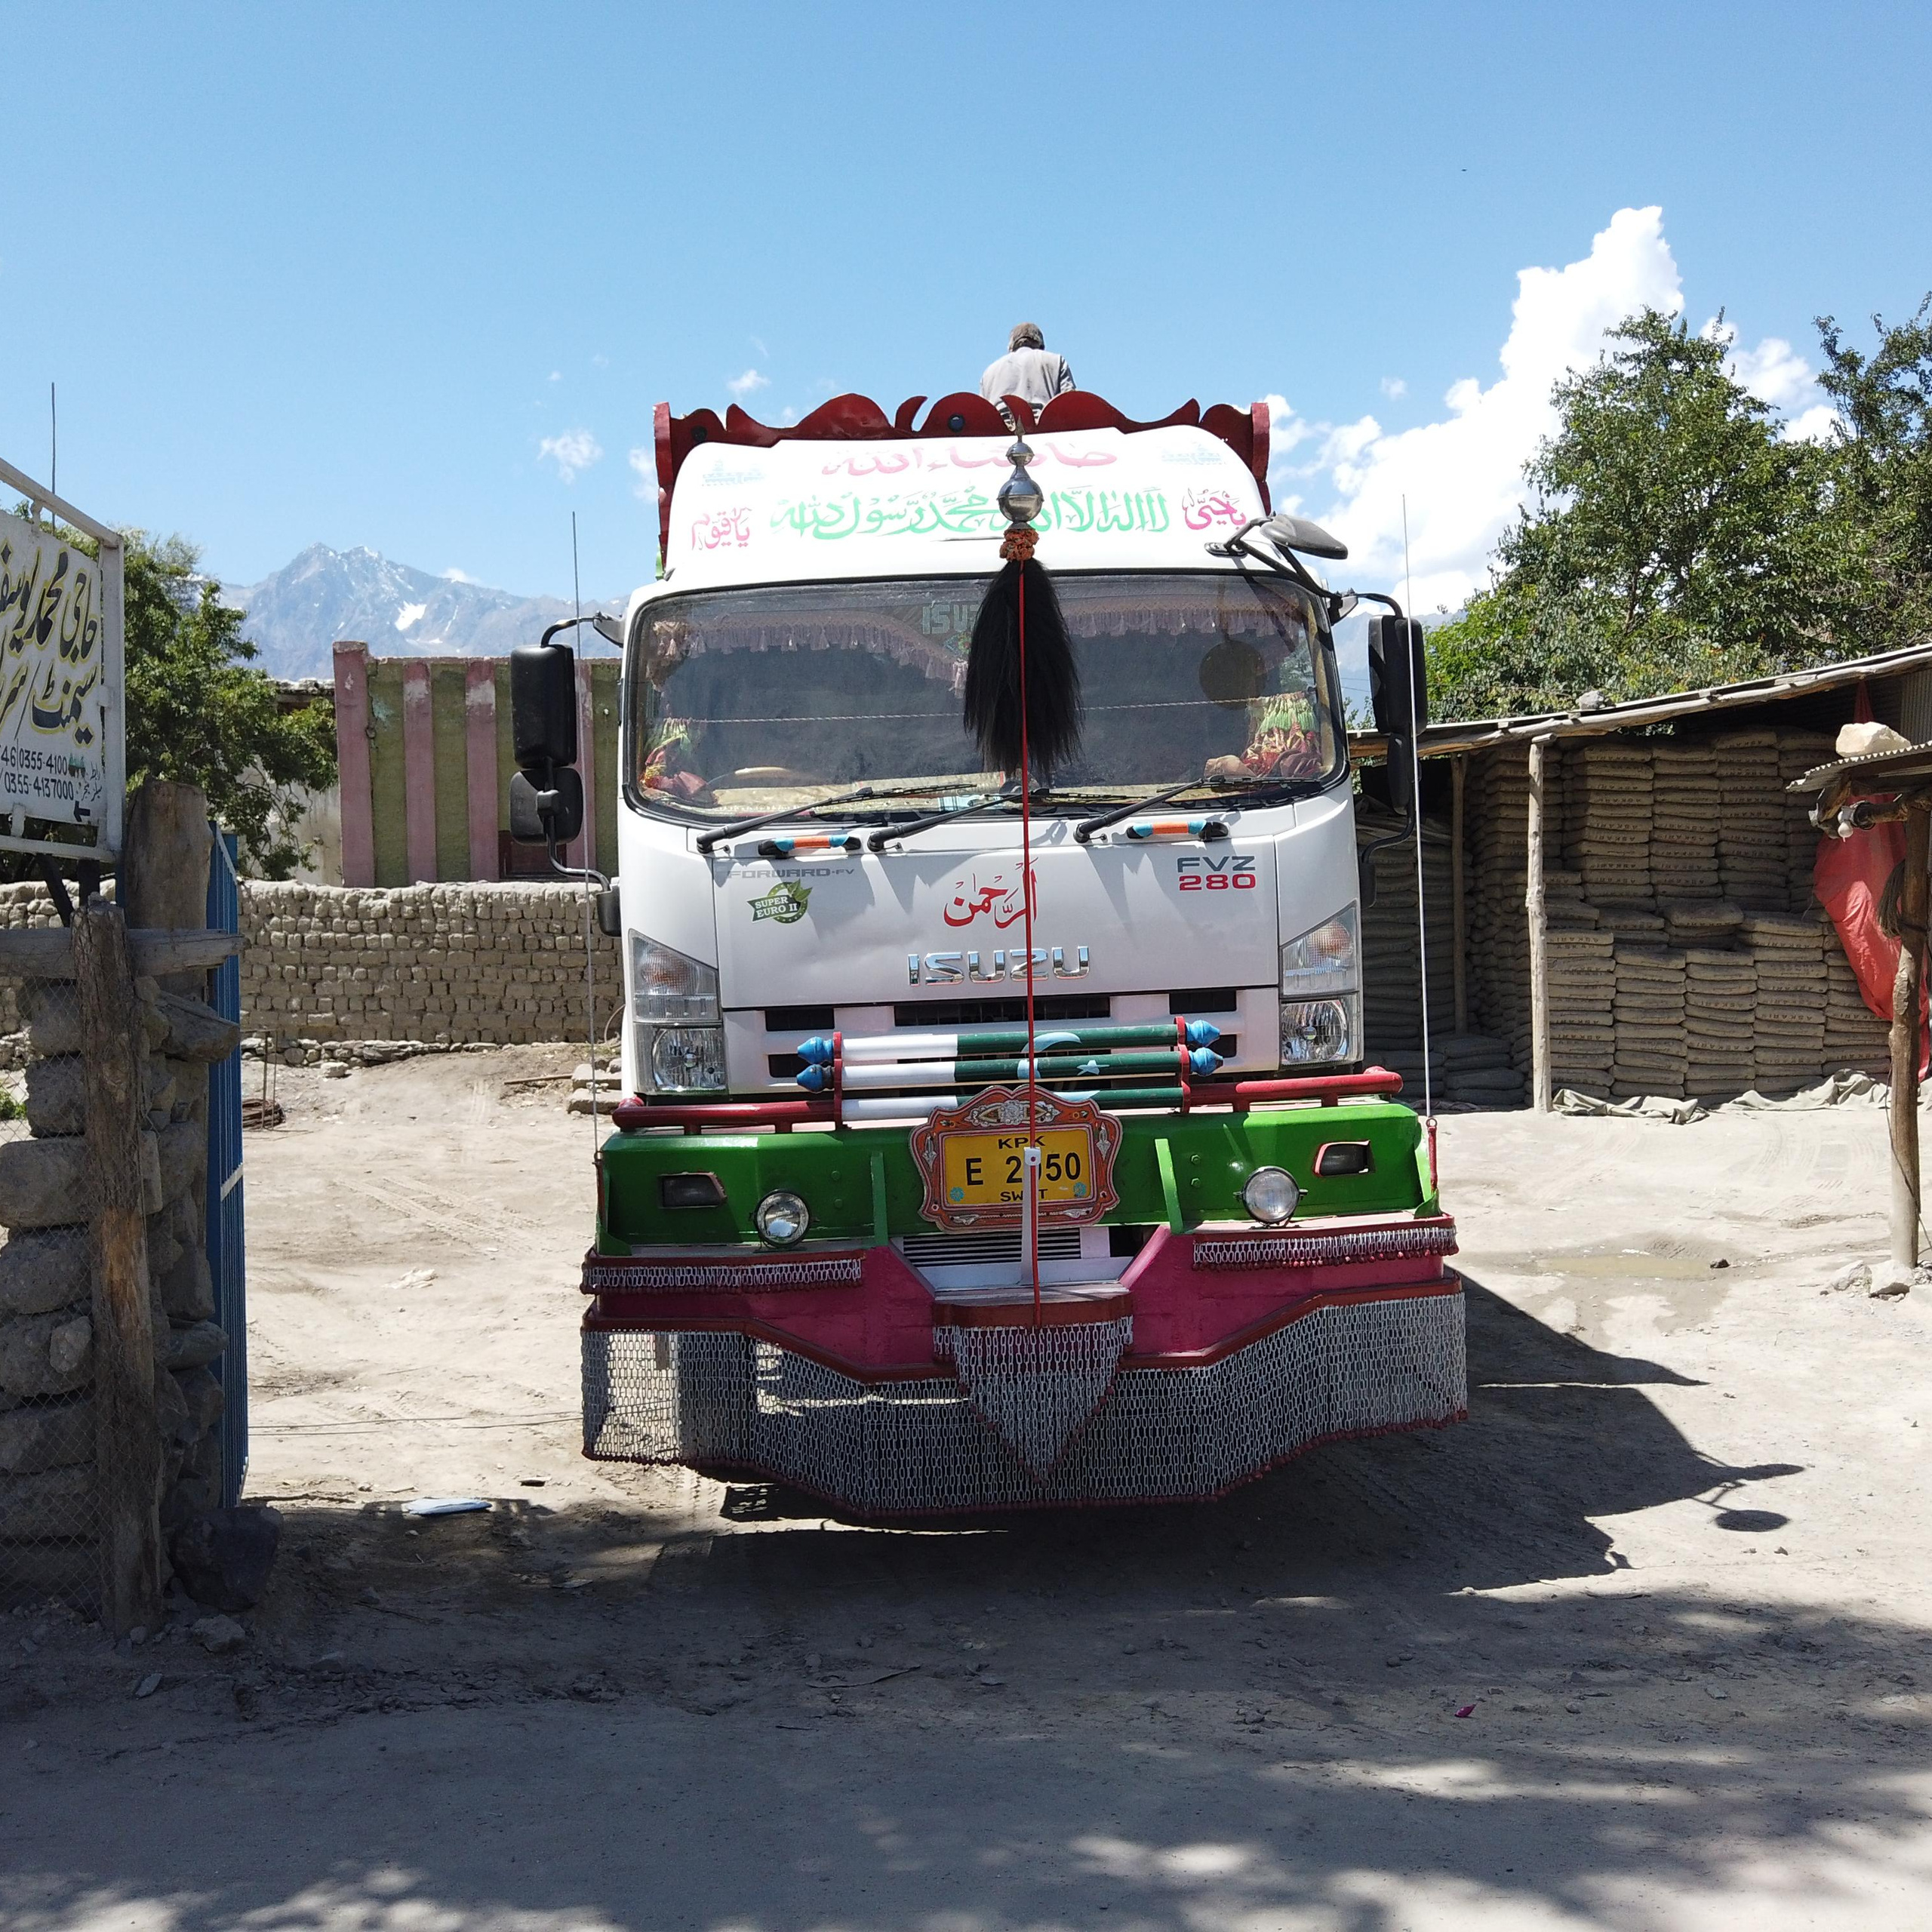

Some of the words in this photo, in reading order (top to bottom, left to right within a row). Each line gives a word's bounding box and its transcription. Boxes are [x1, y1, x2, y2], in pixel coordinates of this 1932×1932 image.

[5, 771, 74, 801] 0355-4137000
[1177, 855, 1257, 873] FVZ
[1179, 873, 1257, 891] 280
[755, 896, 789, 910] SUPER
[756, 905, 786, 918] EURO
[789, 903, 798, 912] II
[907, 946, 1091, 986] ISUZU
[998, 1135, 1046, 1149] KPK
[965, 1157, 984, 1186] E
[1005, 1152, 1081, 1184] 250
[1000, 1189, 1048, 1202] SWT
